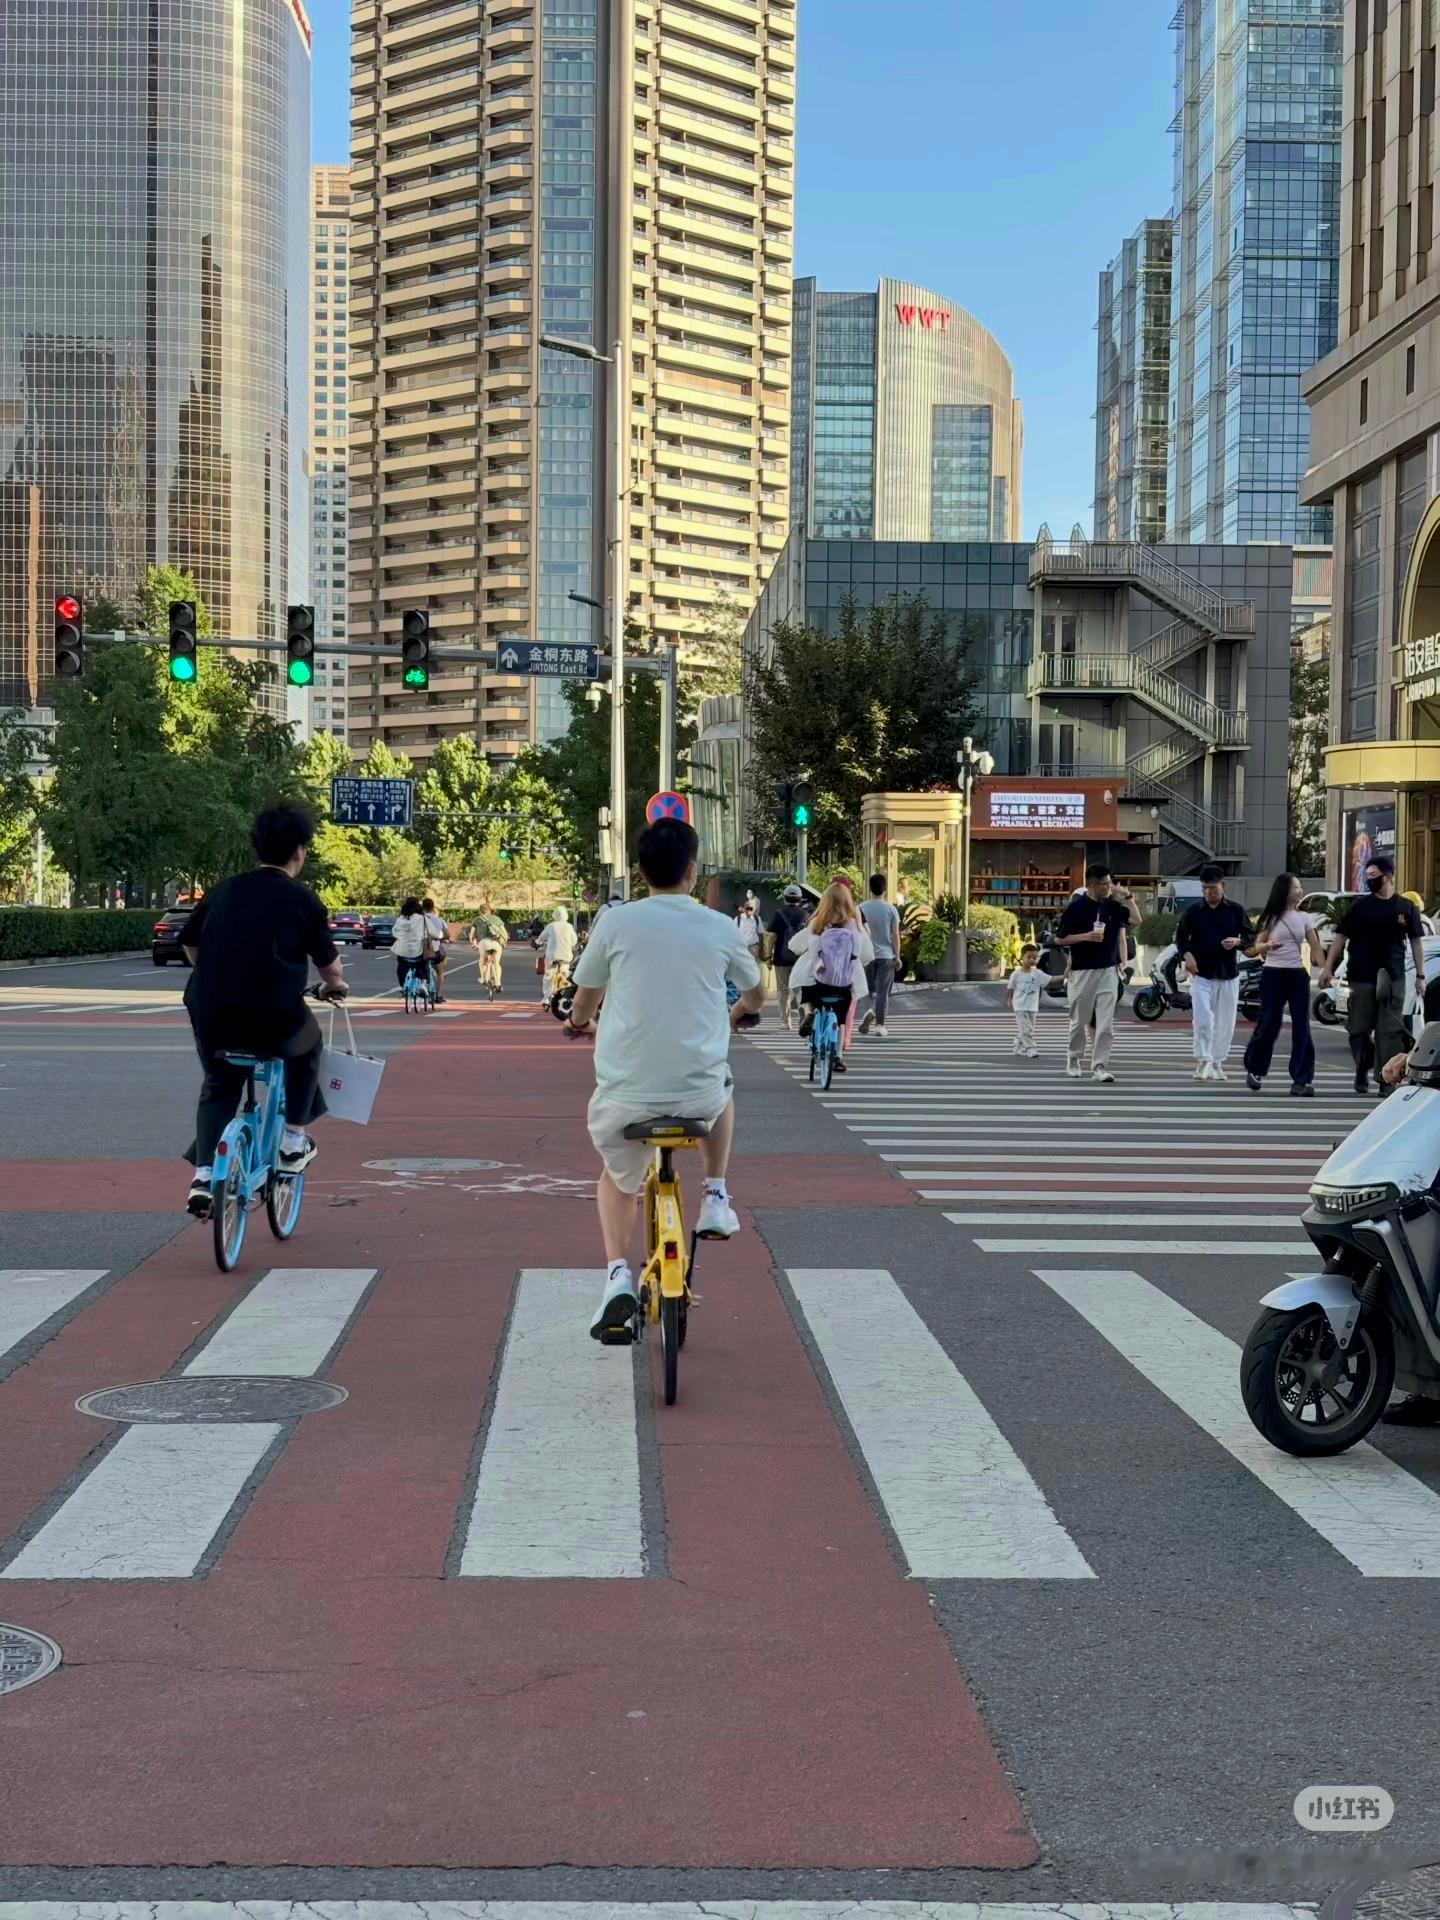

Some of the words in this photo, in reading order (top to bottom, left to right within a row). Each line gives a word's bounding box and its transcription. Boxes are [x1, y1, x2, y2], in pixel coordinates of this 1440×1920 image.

[528, 646, 589, 663] 金桐东路
[528, 662, 558, 673] JINTONG
[560, 664, 577, 674] East
[578, 664, 588, 674] Rd
